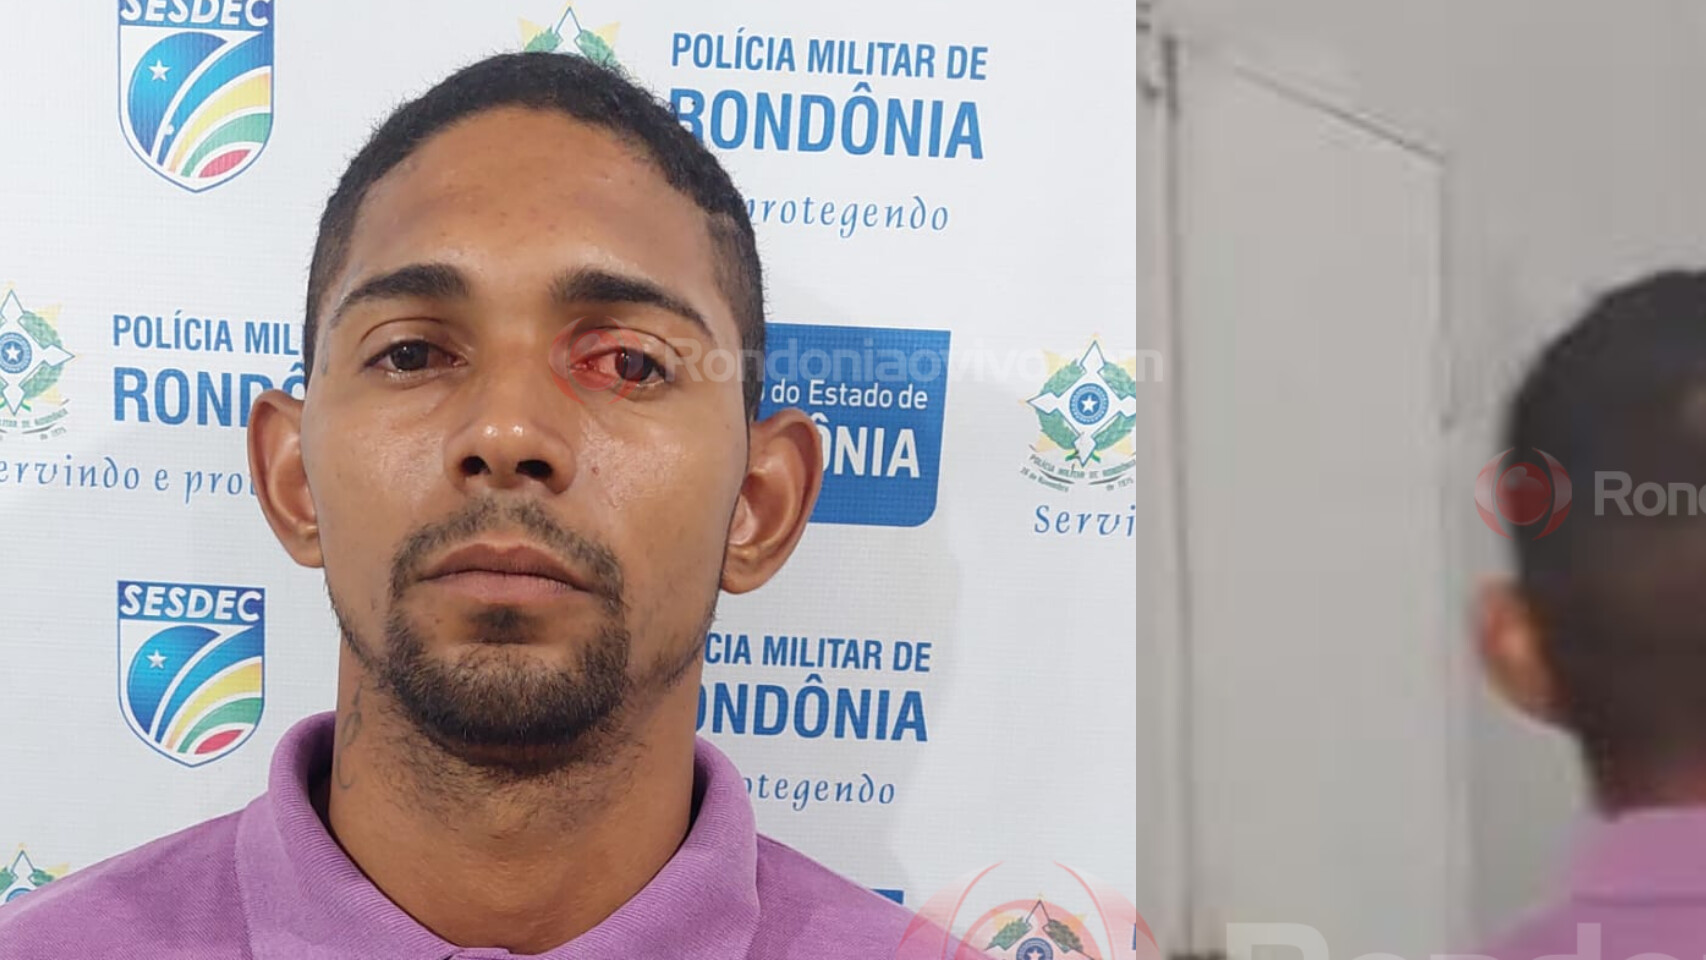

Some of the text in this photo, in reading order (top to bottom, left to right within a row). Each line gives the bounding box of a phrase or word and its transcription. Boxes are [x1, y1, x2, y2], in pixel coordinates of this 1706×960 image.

[120, 0, 269, 27] SESDEC
[671, 27, 989, 80] POLÍCIA MILITAR DE
[113, 310, 304, 356] POLÍCIA MIL
[771, 378, 801, 404] do
[809, 379, 893, 408] Estado
[898, 383, 928, 410] de
[154, 468, 170, 491] e
[1034, 504, 1136, 537] Servi
[120, 584, 262, 621] SESDEC
[762, 635, 883, 670] MILITAR
[892, 641, 932, 672] DE
